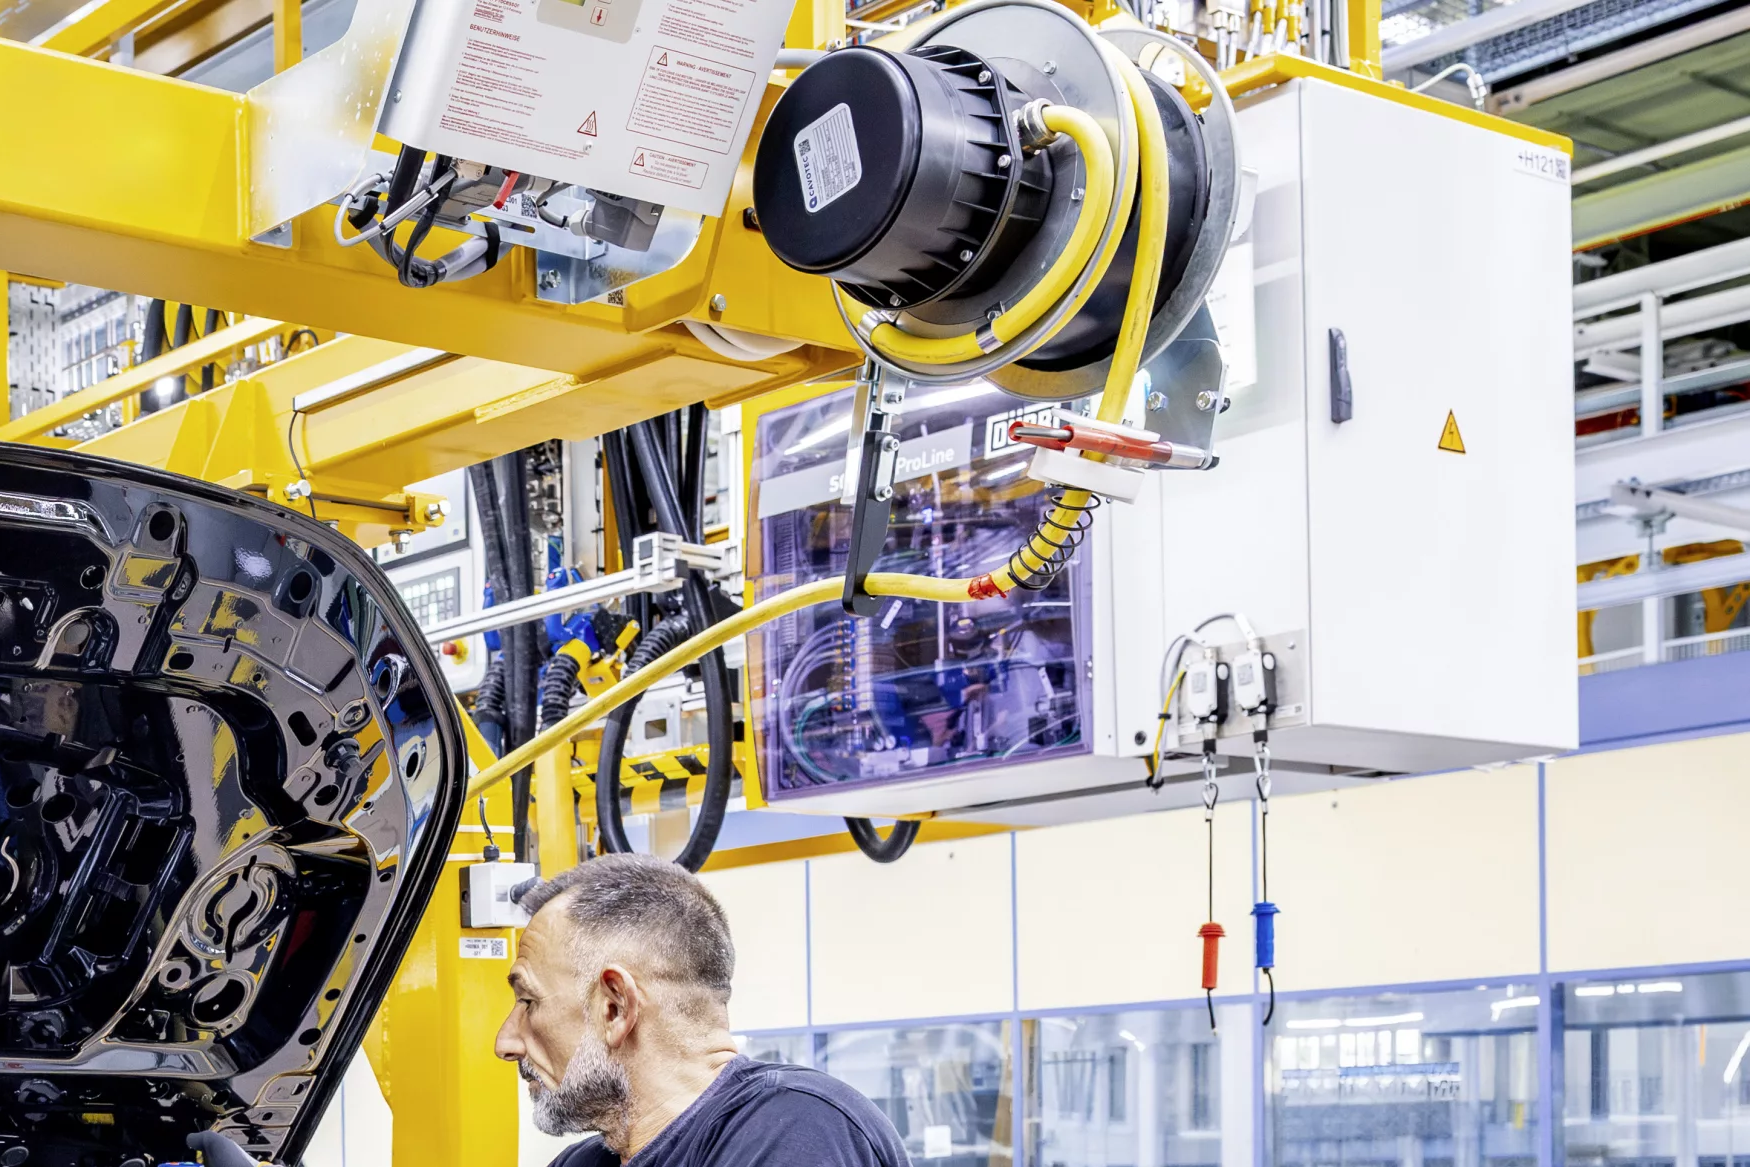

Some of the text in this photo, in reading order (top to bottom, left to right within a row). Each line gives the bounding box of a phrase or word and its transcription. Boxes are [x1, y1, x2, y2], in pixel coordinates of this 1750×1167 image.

[469, 23, 521, 42] BENUTZERHINWEISE
[676, 60, 696, 70] WARNING
[802, 155, 815, 197] CAVOTEC
